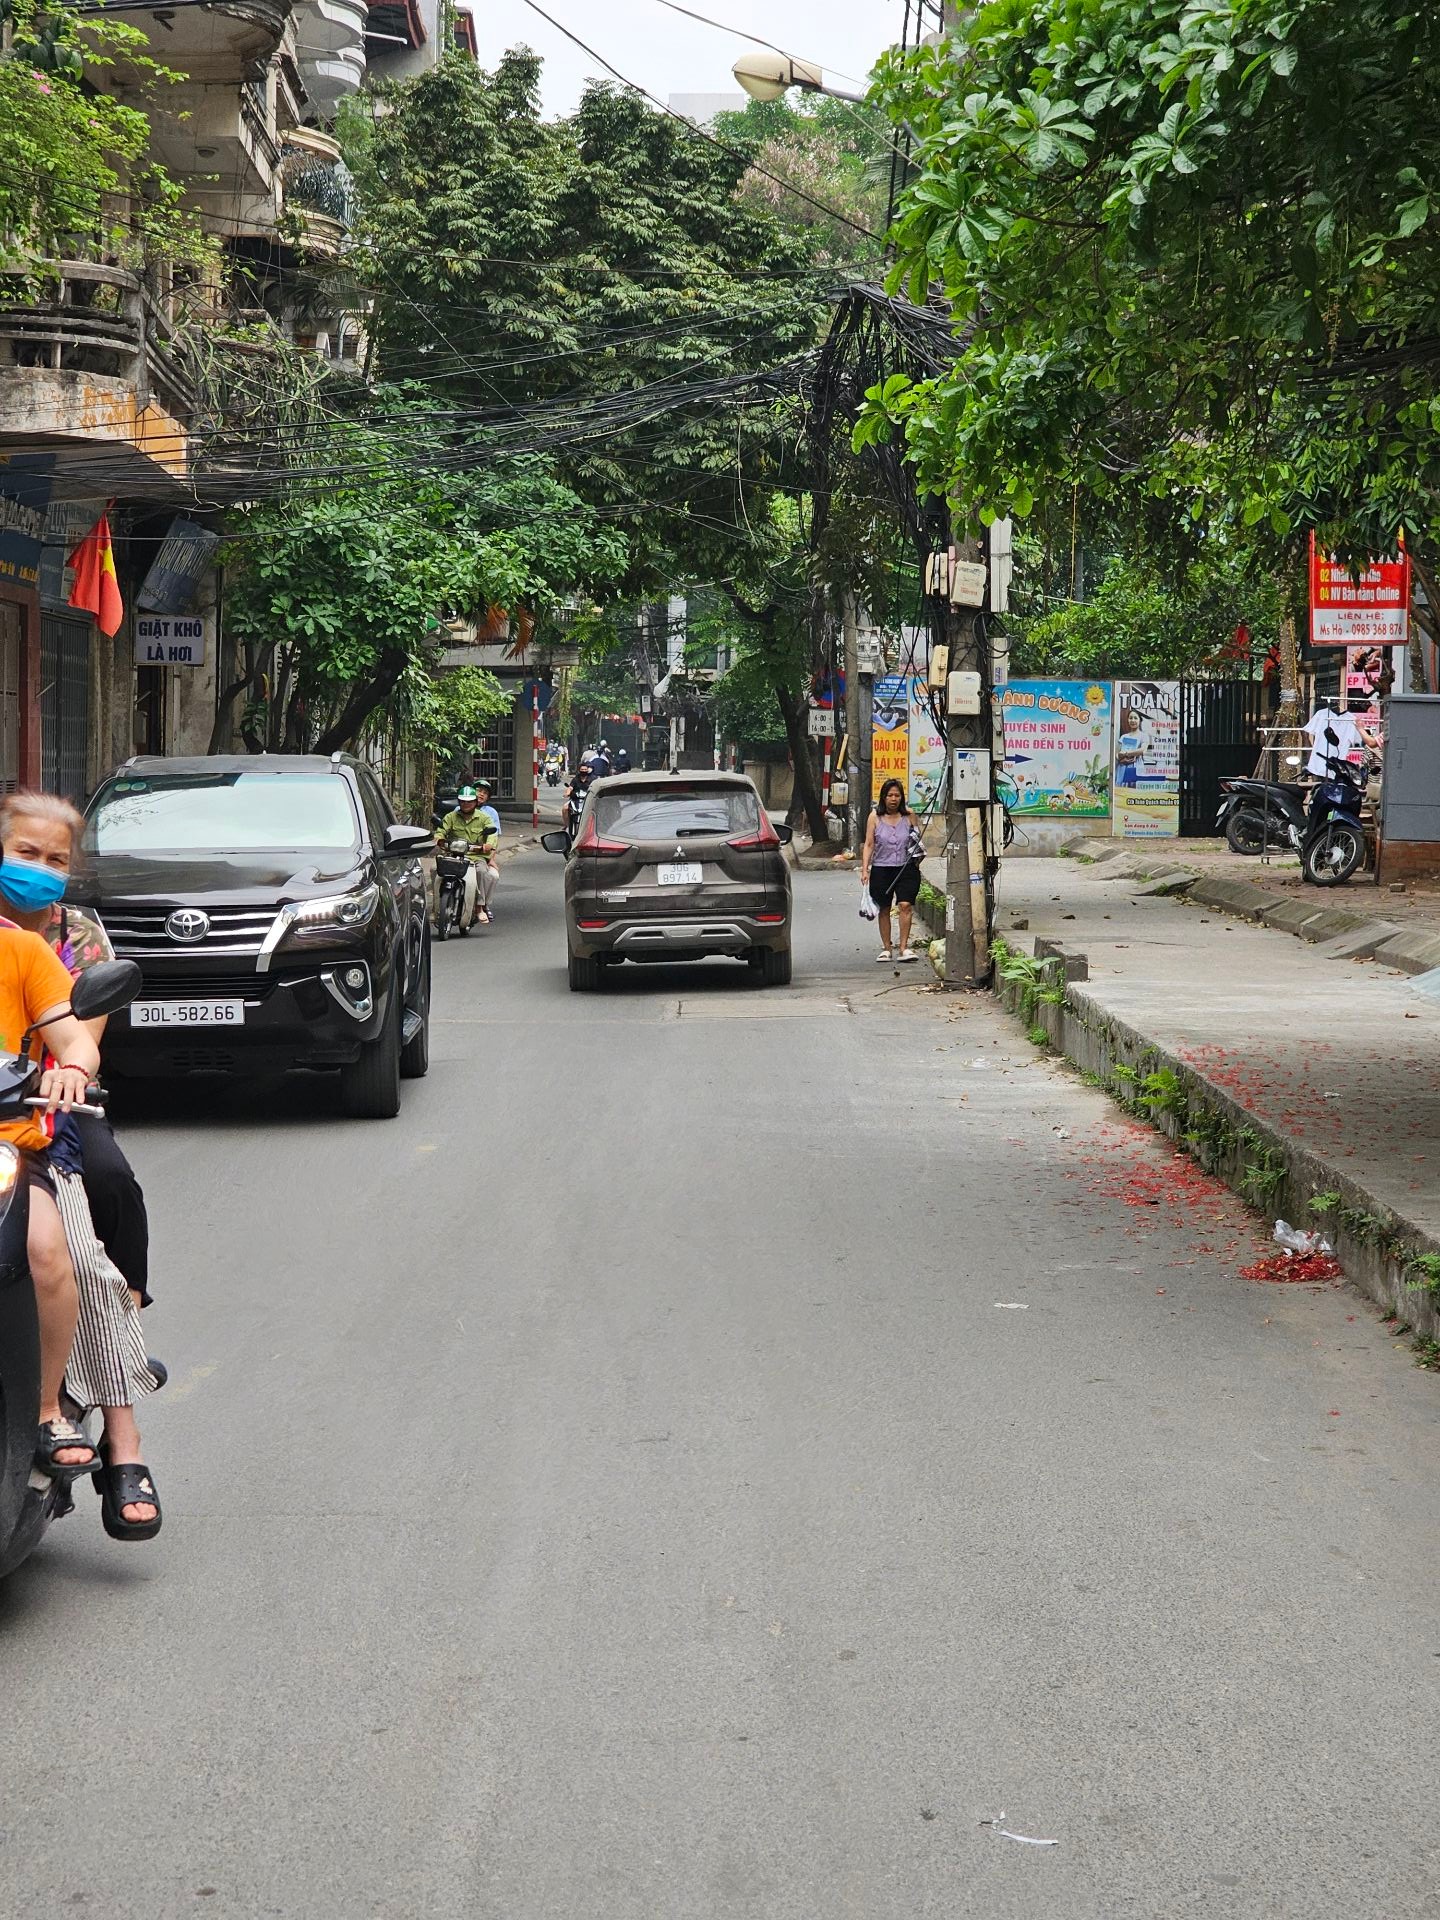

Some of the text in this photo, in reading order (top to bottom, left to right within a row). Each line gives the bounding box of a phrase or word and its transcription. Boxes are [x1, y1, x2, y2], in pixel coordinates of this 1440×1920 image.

[1320, 569, 1330, 583] 02
[1320, 587, 1330, 601] 04
[1331, 587, 1342, 601] NV
[1376, 587, 1400, 601] Online
[1338, 611, 1361, 620] LIÊN
[138, 619, 203, 639] GIẶT KHÔ
[1320, 624, 1330, 636] Ms
[1351, 623, 1371, 635] 0985
[1373, 623, 1387, 635] 368
[1390, 623, 1403, 636] 876
[147, 643, 192, 661] LÀ HƠI
[1003, 689, 1035, 708] ÁNH
[1038, 694, 1091, 725] DƯƠNG
[1119, 691, 1170, 709] TOÁN
[1040, 724, 1067, 734] SINH
[874, 737, 907, 755] ĐÀO TẠO
[928, 736, 944, 747] CÁ
[1033, 737, 1055, 750] ĐẾN
[1058, 740, 1064, 750] 5
[1068, 737, 1091, 751] TUỔI
[874, 755, 906, 770] LÁI XE
[662, 872, 697, 884] 897.14
[140, 1006, 235, 1023] 30L-582.66
